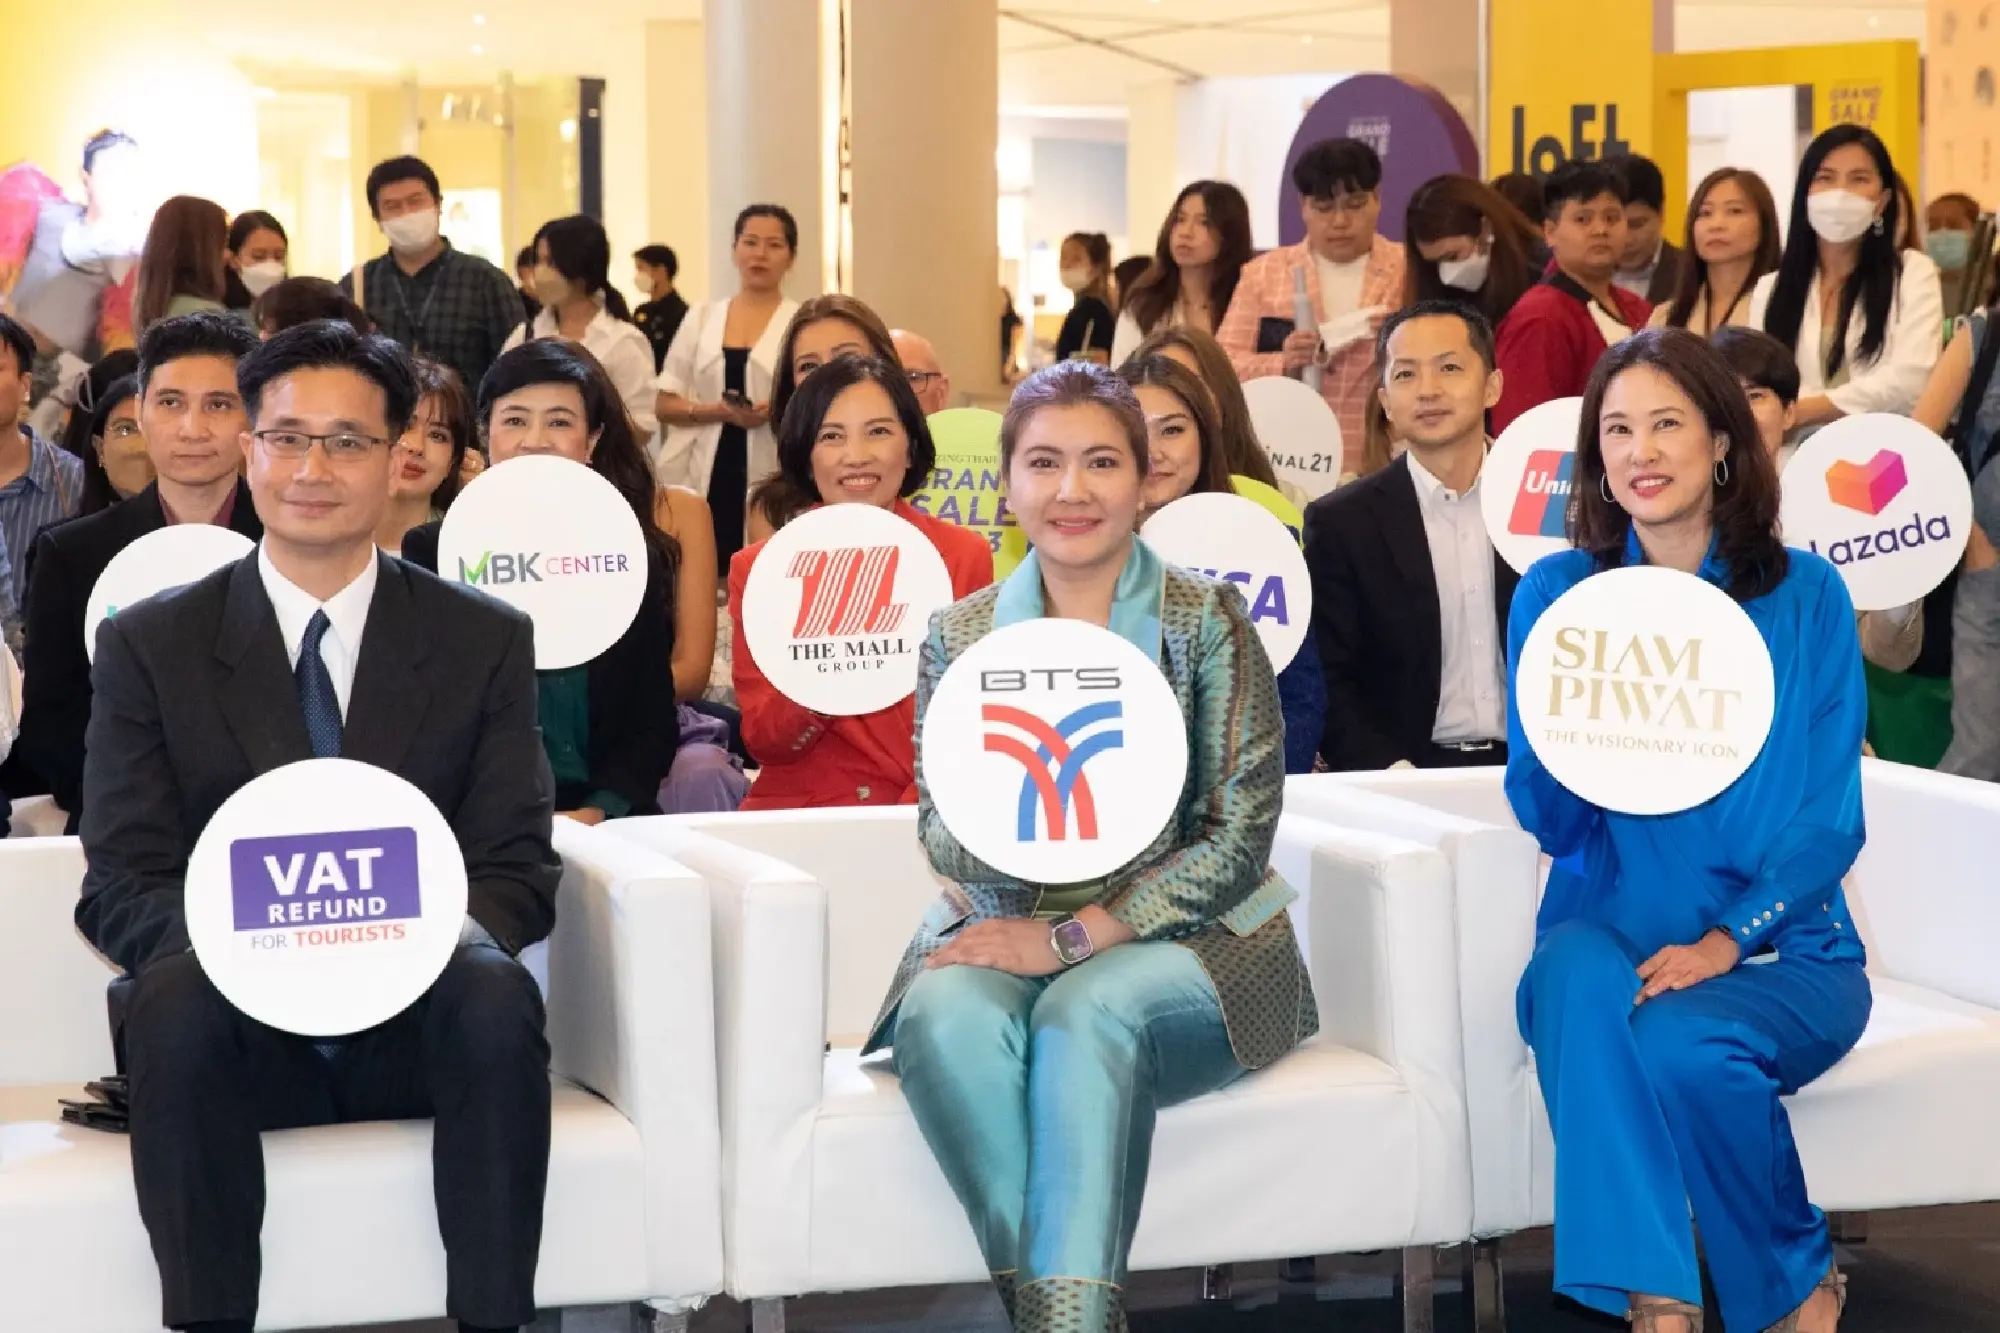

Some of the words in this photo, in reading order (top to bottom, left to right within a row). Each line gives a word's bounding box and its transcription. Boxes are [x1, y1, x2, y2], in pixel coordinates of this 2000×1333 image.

[1271, 452, 1333, 473] NAL21
[919, 467, 1000, 490] RAN
[458, 551, 543, 585] MBK
[546, 554, 629, 575] CENTER
[788, 642, 836, 661] THE
[844, 638, 912, 658] MALL
[1552, 626, 1703, 681] SIAM
[817, 659, 885, 673] GROUP
[981, 666, 1122, 692] BTS
[1545, 674, 1742, 732] PIWAT
[1544, 729, 1579, 744] THE
[1586, 732, 1687, 754] VISIONARY
[1693, 742, 1740, 759] ICON
[263, 847, 384, 896] VAT
[268, 896, 388, 924] REFUND
[252, 933, 288, 950] FOR
[294, 923, 406, 948] TOURISTS
